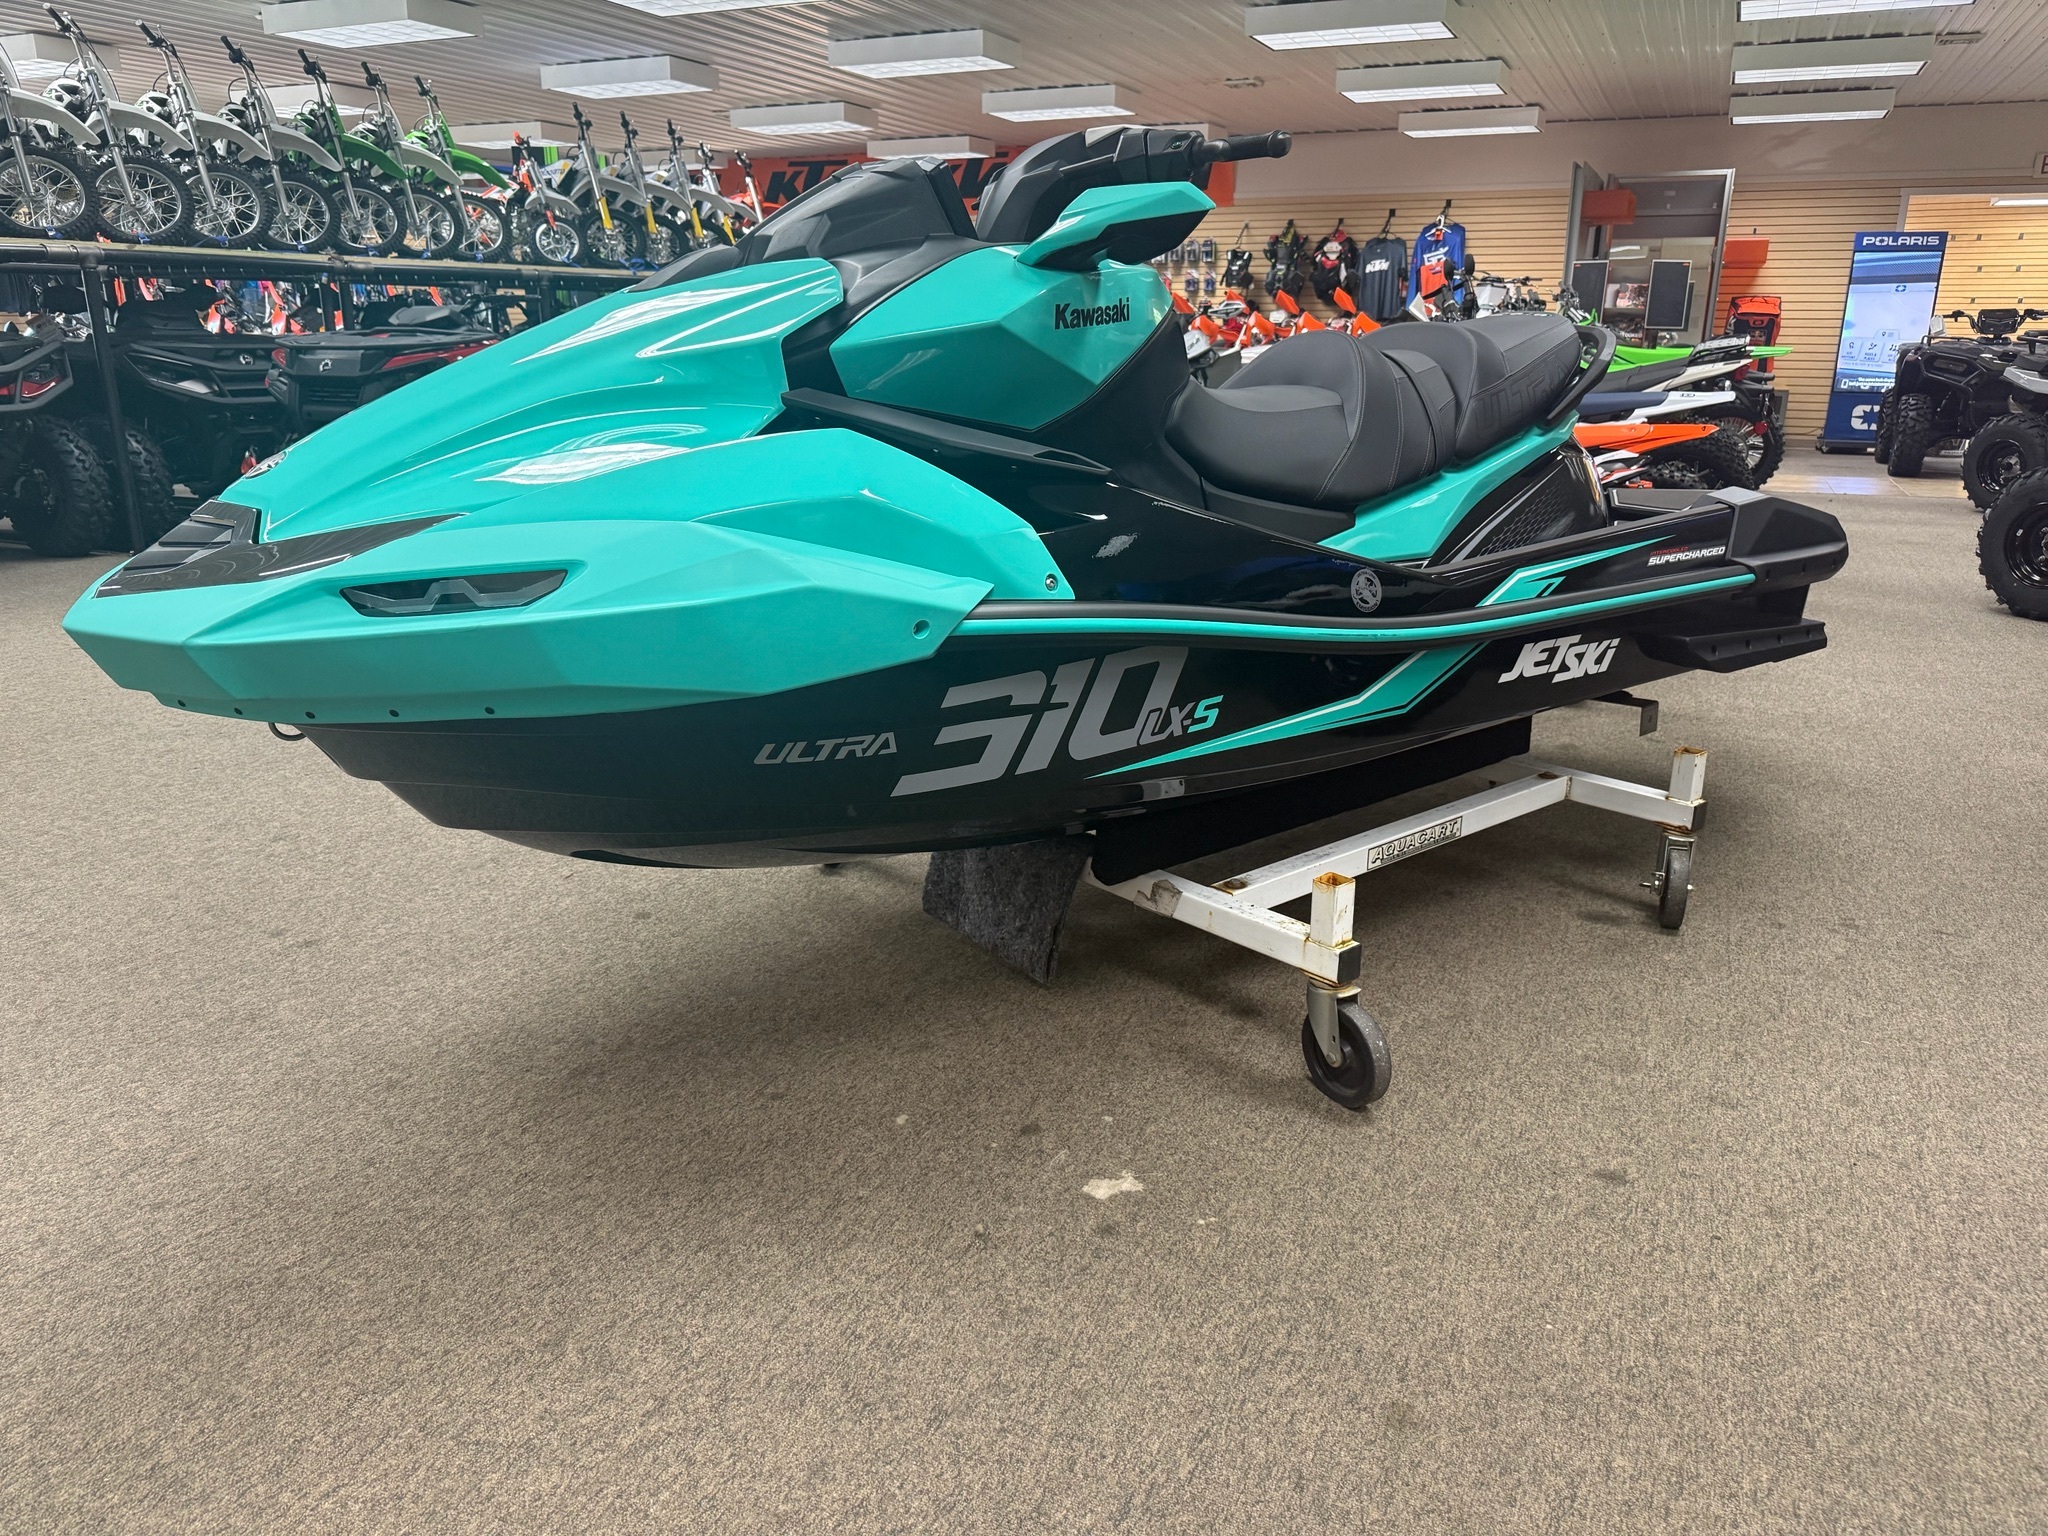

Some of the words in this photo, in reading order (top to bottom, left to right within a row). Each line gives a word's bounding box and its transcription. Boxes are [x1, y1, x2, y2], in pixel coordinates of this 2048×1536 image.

[763, 160, 848, 204] KT
[1862, 235, 1940, 246] POLARIS
[1365, 259, 1390, 274] KTM
[1055, 297, 1130, 330] Kawasaki
[1647, 546, 1726, 567] SUPERCHARGED
[753, 731, 898, 766] ULTRA
[890, 646, 1189, 797] 310
[1371, 821, 1457, 864] AQUACART
